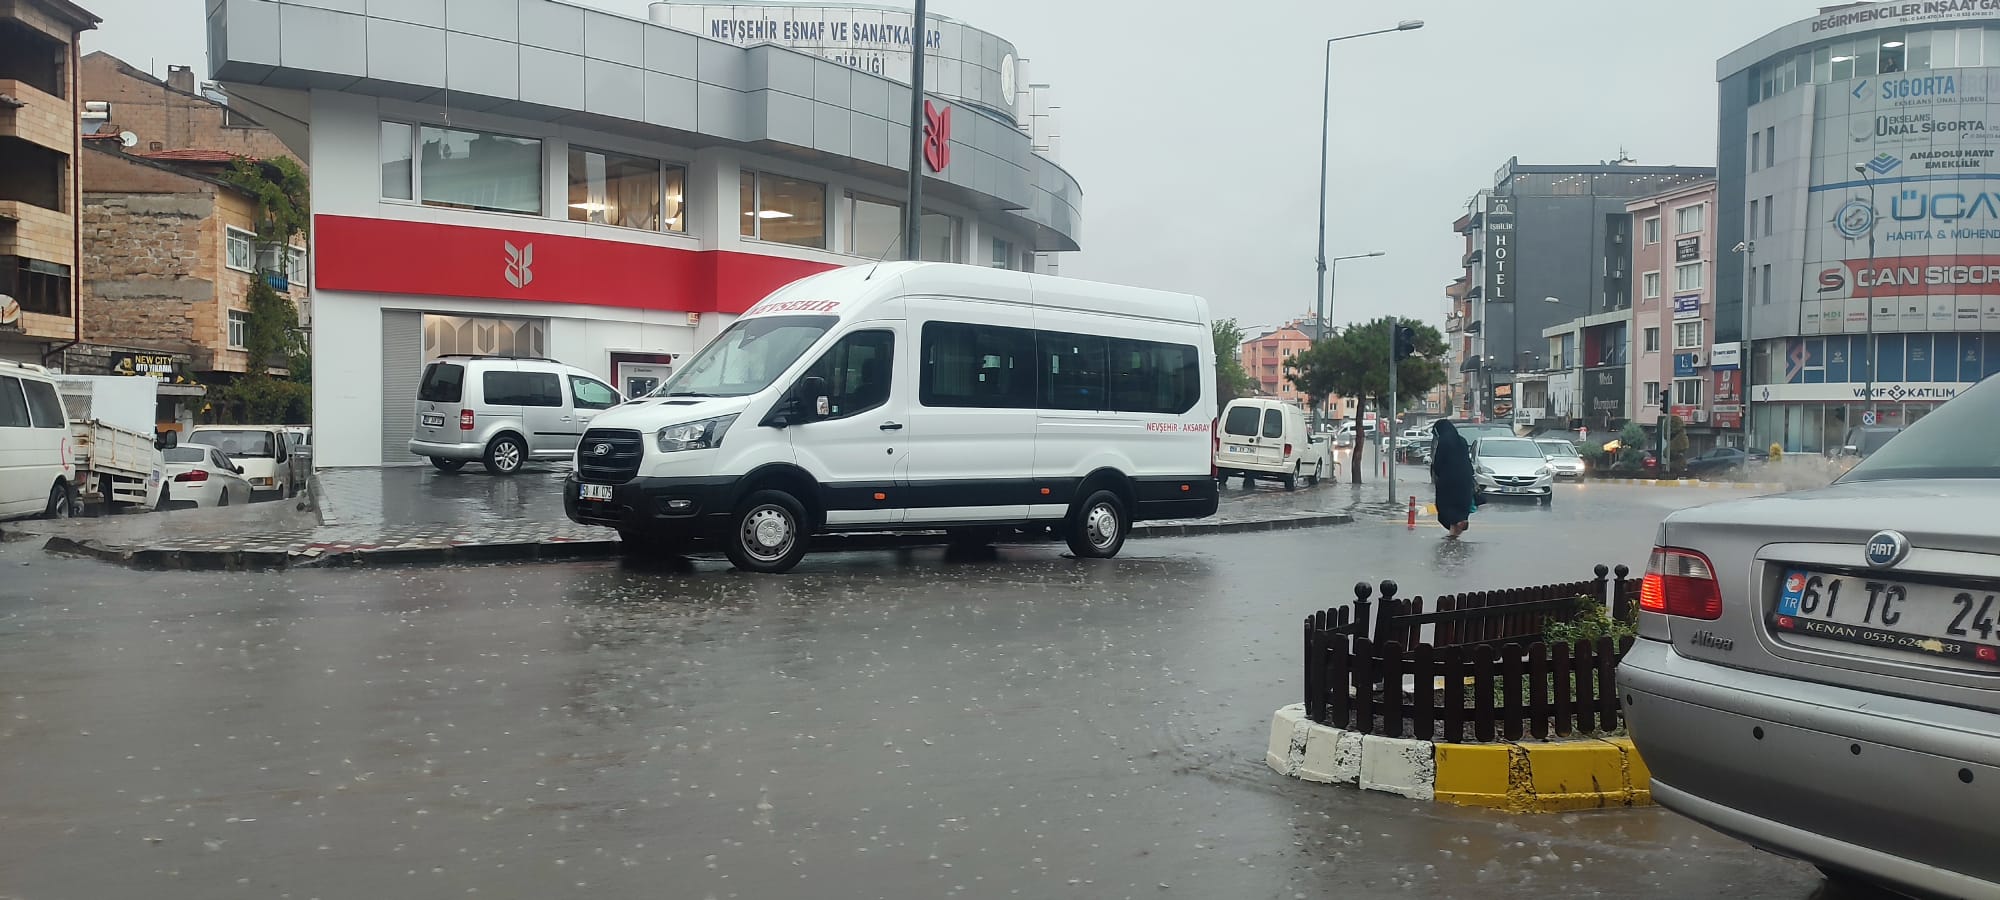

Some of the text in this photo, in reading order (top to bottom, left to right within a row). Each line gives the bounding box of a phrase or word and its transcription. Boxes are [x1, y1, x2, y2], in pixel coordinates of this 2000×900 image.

[1812, 3, 1921, 33] DEĞİRMENCİLER
[1980, 0, 2000, 9] GA
[711, 16, 940, 49] NEVŞEHİR ESNAF VE SANATKAAR
[1889, 114, 1931, 125] EKSELANS
[1921, 119, 1985, 133] SİGORTA
[1909, 150, 1995, 160] ANADOLU HAYAT
[1925, 159, 1980, 169] EMEKLİLİK
[1936, 229, 1946, 239] &
[1495, 234, 1507, 298] HOTEL
[1857, 266, 1919, 287] CAN
[135, 355, 173, 365] NEW CITY
[1908, 388, 1955, 398] KATILIM
[1146, 422, 1178, 433] NEVŞEHİR
[1183, 423, 1210, 432] AKSARAY
[1869, 543, 1894, 556] FIAT
[1784, 596, 1798, 609] TR
[1801, 575, 2000, 640] 61 TC 24
[1806, 621, 1857, 638] KENAN
[1863, 631, 1896, 643] 0535
[1691, 630, 1733, 651] Albea
